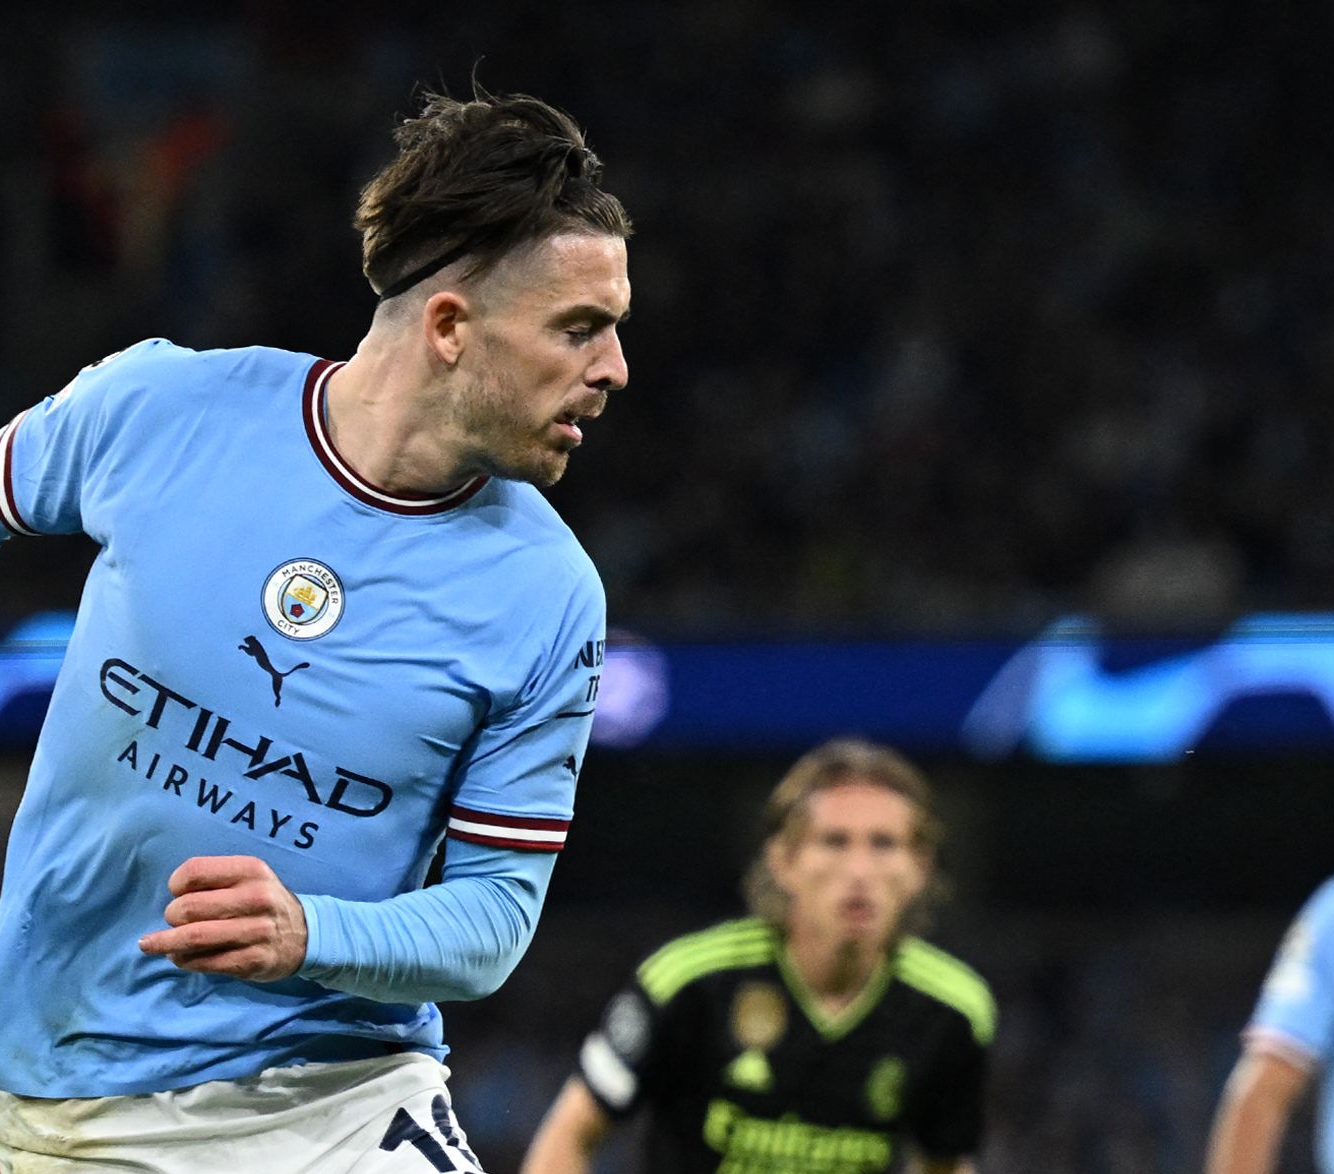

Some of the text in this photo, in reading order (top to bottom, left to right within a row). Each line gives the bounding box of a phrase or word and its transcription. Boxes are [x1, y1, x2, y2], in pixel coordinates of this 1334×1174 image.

[282, 564, 339, 604] MANCHESTER
[277, 619, 300, 635] CITY
[100, 658, 393, 817] ETIHAD
[117, 740, 319, 849] AIRWAYS
